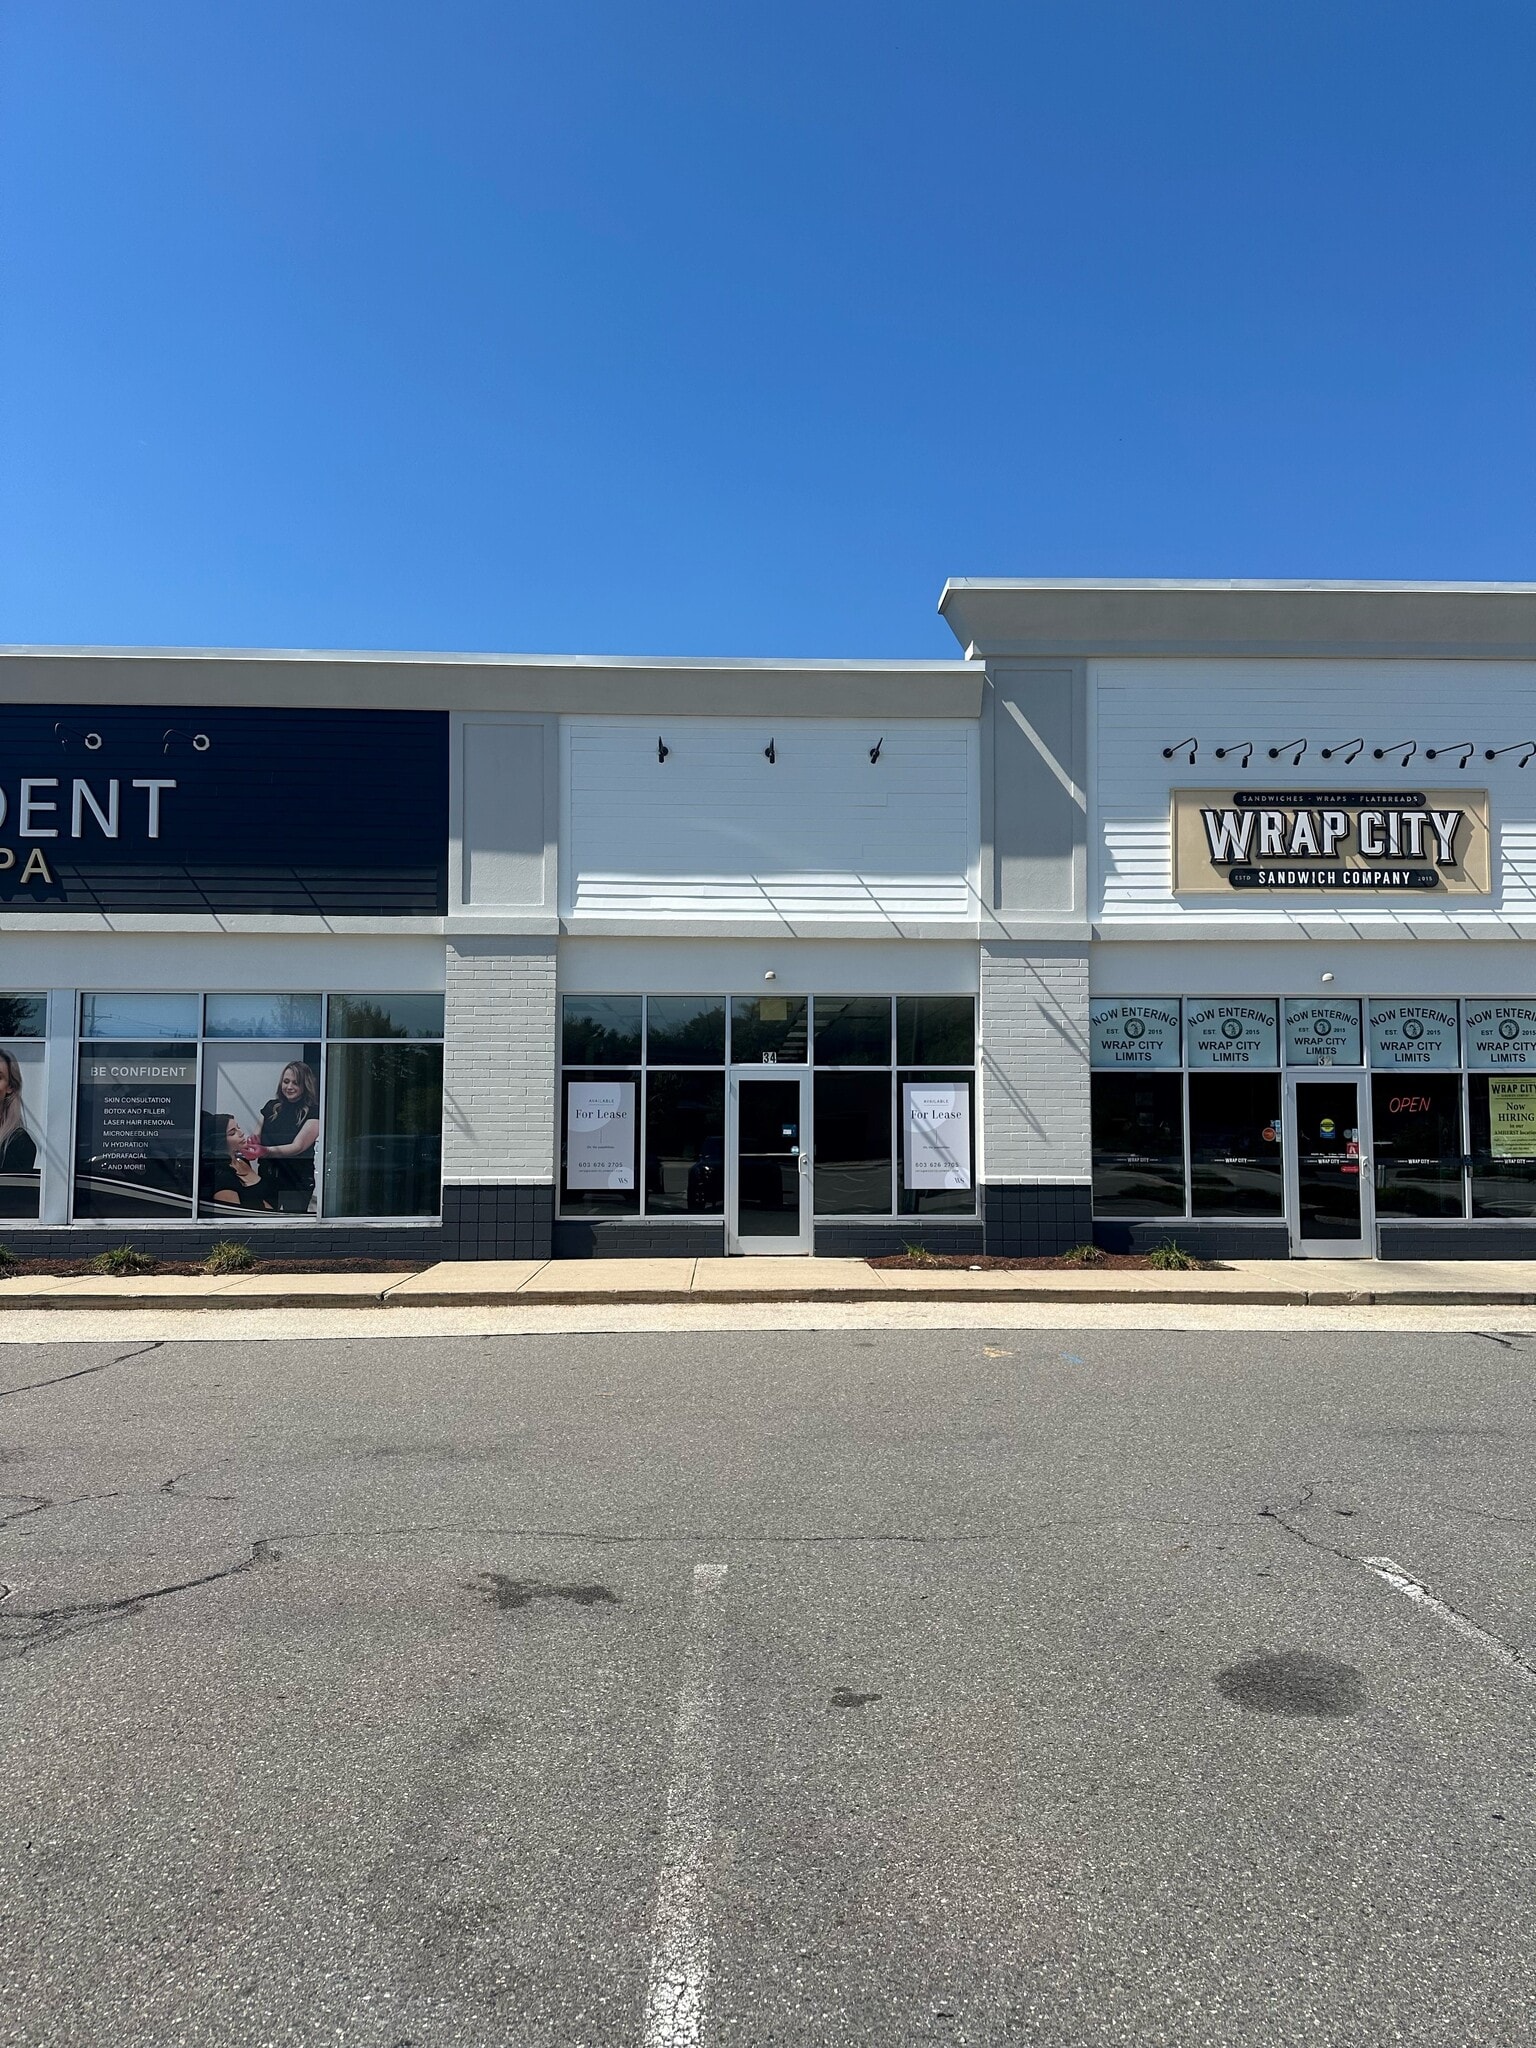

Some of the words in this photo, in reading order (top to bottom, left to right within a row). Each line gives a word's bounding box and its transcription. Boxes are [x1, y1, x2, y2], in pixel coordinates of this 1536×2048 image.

[0, 778, 177, 838] ENT
[1200, 809, 1349, 865] WRAP
[1358, 810, 1465, 866] CITY
[1258, 871, 1336, 884] SANDWICH
[1343, 871, 1410, 885] COMPANY
[1091, 1008, 1118, 1026] NOW
[1121, 1007, 1178, 1027] ENTERING
[1188, 1009, 1215, 1027] NOW
[1218, 1007, 1275, 1027] ENTERING
[1286, 1010, 1309, 1026] NOW
[1311, 1009, 1358, 1026] ENTERING
[1370, 1009, 1396, 1027] NOW
[1400, 1007, 1456, 1027] ENTERING
[1466, 1009, 1492, 1028] NOW
[1495, 1007, 1536, 1022] ENTERI
[1101, 1041, 1135, 1050] WRAP
[1138, 1041, 1164, 1050] CITY
[1198, 1041, 1233, 1050] WRAP
[1236, 1041, 1261, 1050] CITY
[1294, 1037, 1323, 1045] WRAP
[1325, 1037, 1347, 1045] CITY
[1306, 1047, 1337, 1055] LIMITS
[1380, 1042, 1414, 1051] WRAP
[1417, 1042, 1442, 1051] CITY
[1476, 1042, 1510, 1051] WRAP
[1512, 1042, 1536, 1051] CITY
[763, 1052, 776, 1064] 34
[1115, 1052, 1152, 1061] LIMITS
[1212, 1053, 1249, 1062] LIMITS
[1395, 1053, 1431, 1062] LIMITS
[1490, 1053, 1526, 1063] LIMITS
[91, 1067, 107, 1077] BE
[111, 1067, 187, 1077] CONFIDENT
[1491, 1084, 1518, 1095] WRAP
[1389, 1097, 1431, 1113] OPEN
[1506, 1102, 1526, 1110] Now
[576, 1109, 594, 1119] For
[597, 1109, 628, 1119] Lease
[911, 1110, 929, 1119] For
[932, 1110, 962, 1119] Lease
[1498, 1113, 1535, 1121] HIRING
